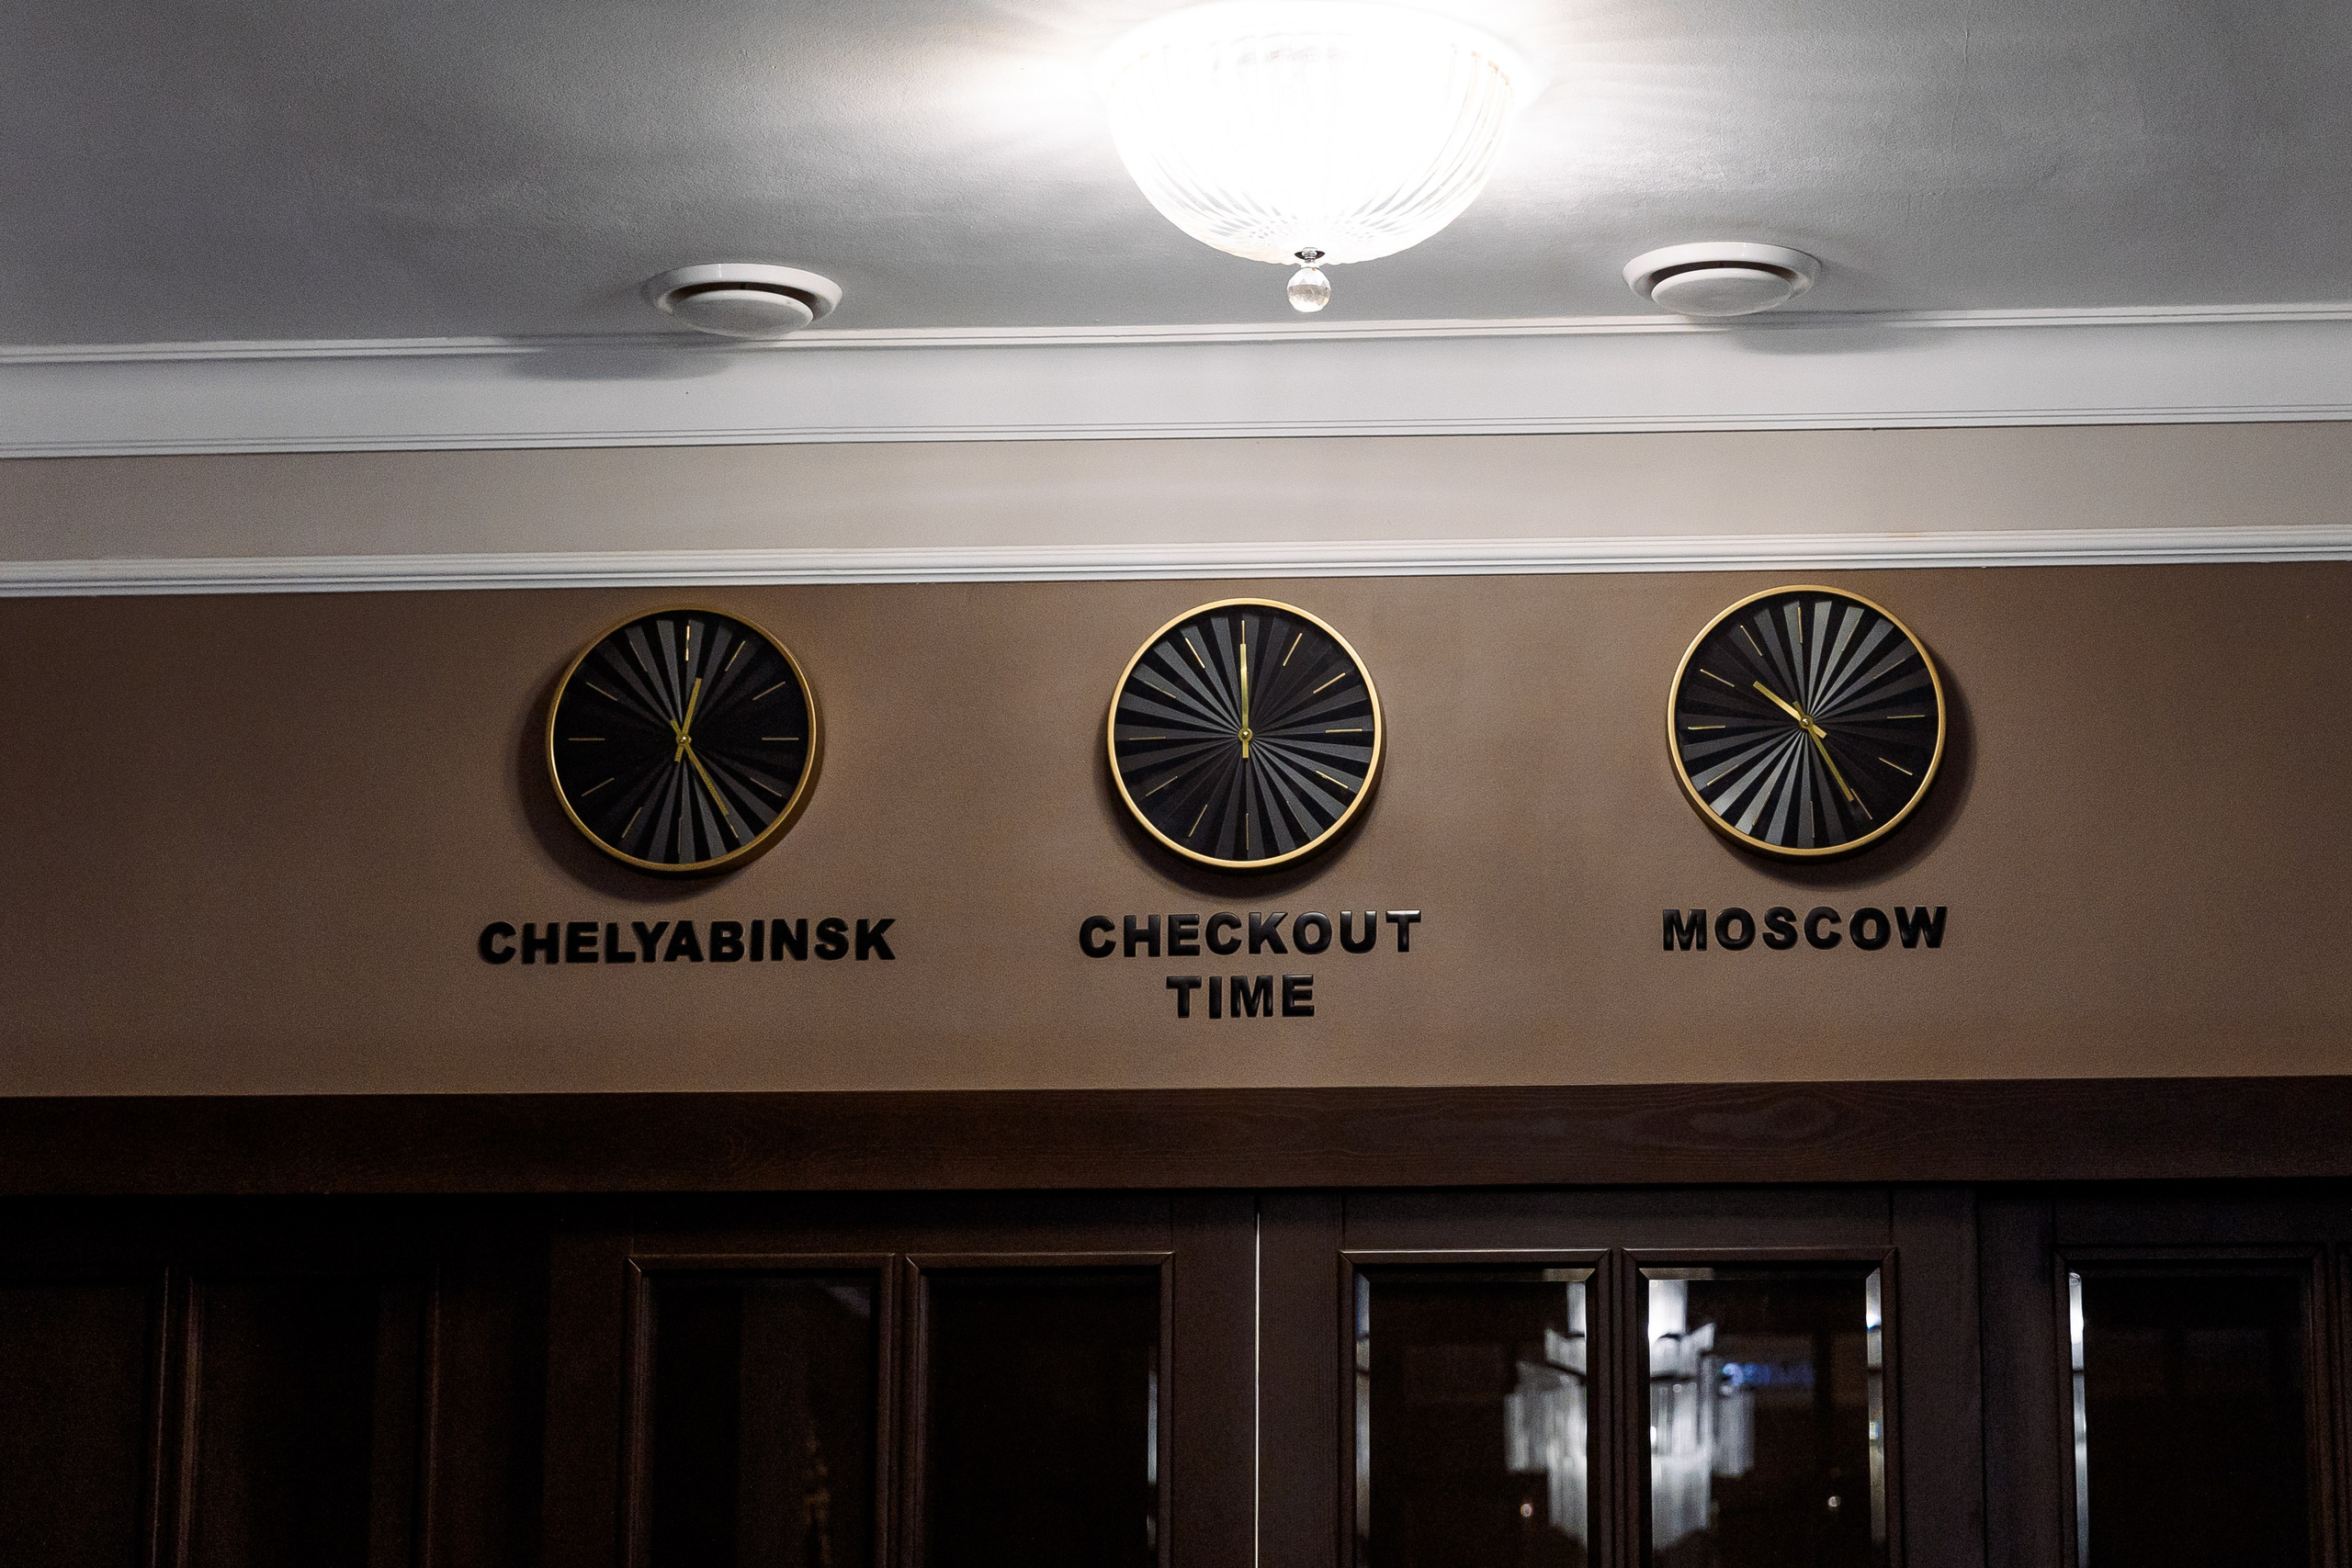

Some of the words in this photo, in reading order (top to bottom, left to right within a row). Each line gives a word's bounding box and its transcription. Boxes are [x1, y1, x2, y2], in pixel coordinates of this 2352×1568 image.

[479, 917, 897, 964] CHELYABINSK
[1080, 909, 1421, 958] CHECKOUT
[1662, 906, 1948, 952] MOSCOW
[1166, 974, 1315, 1019] TIME
